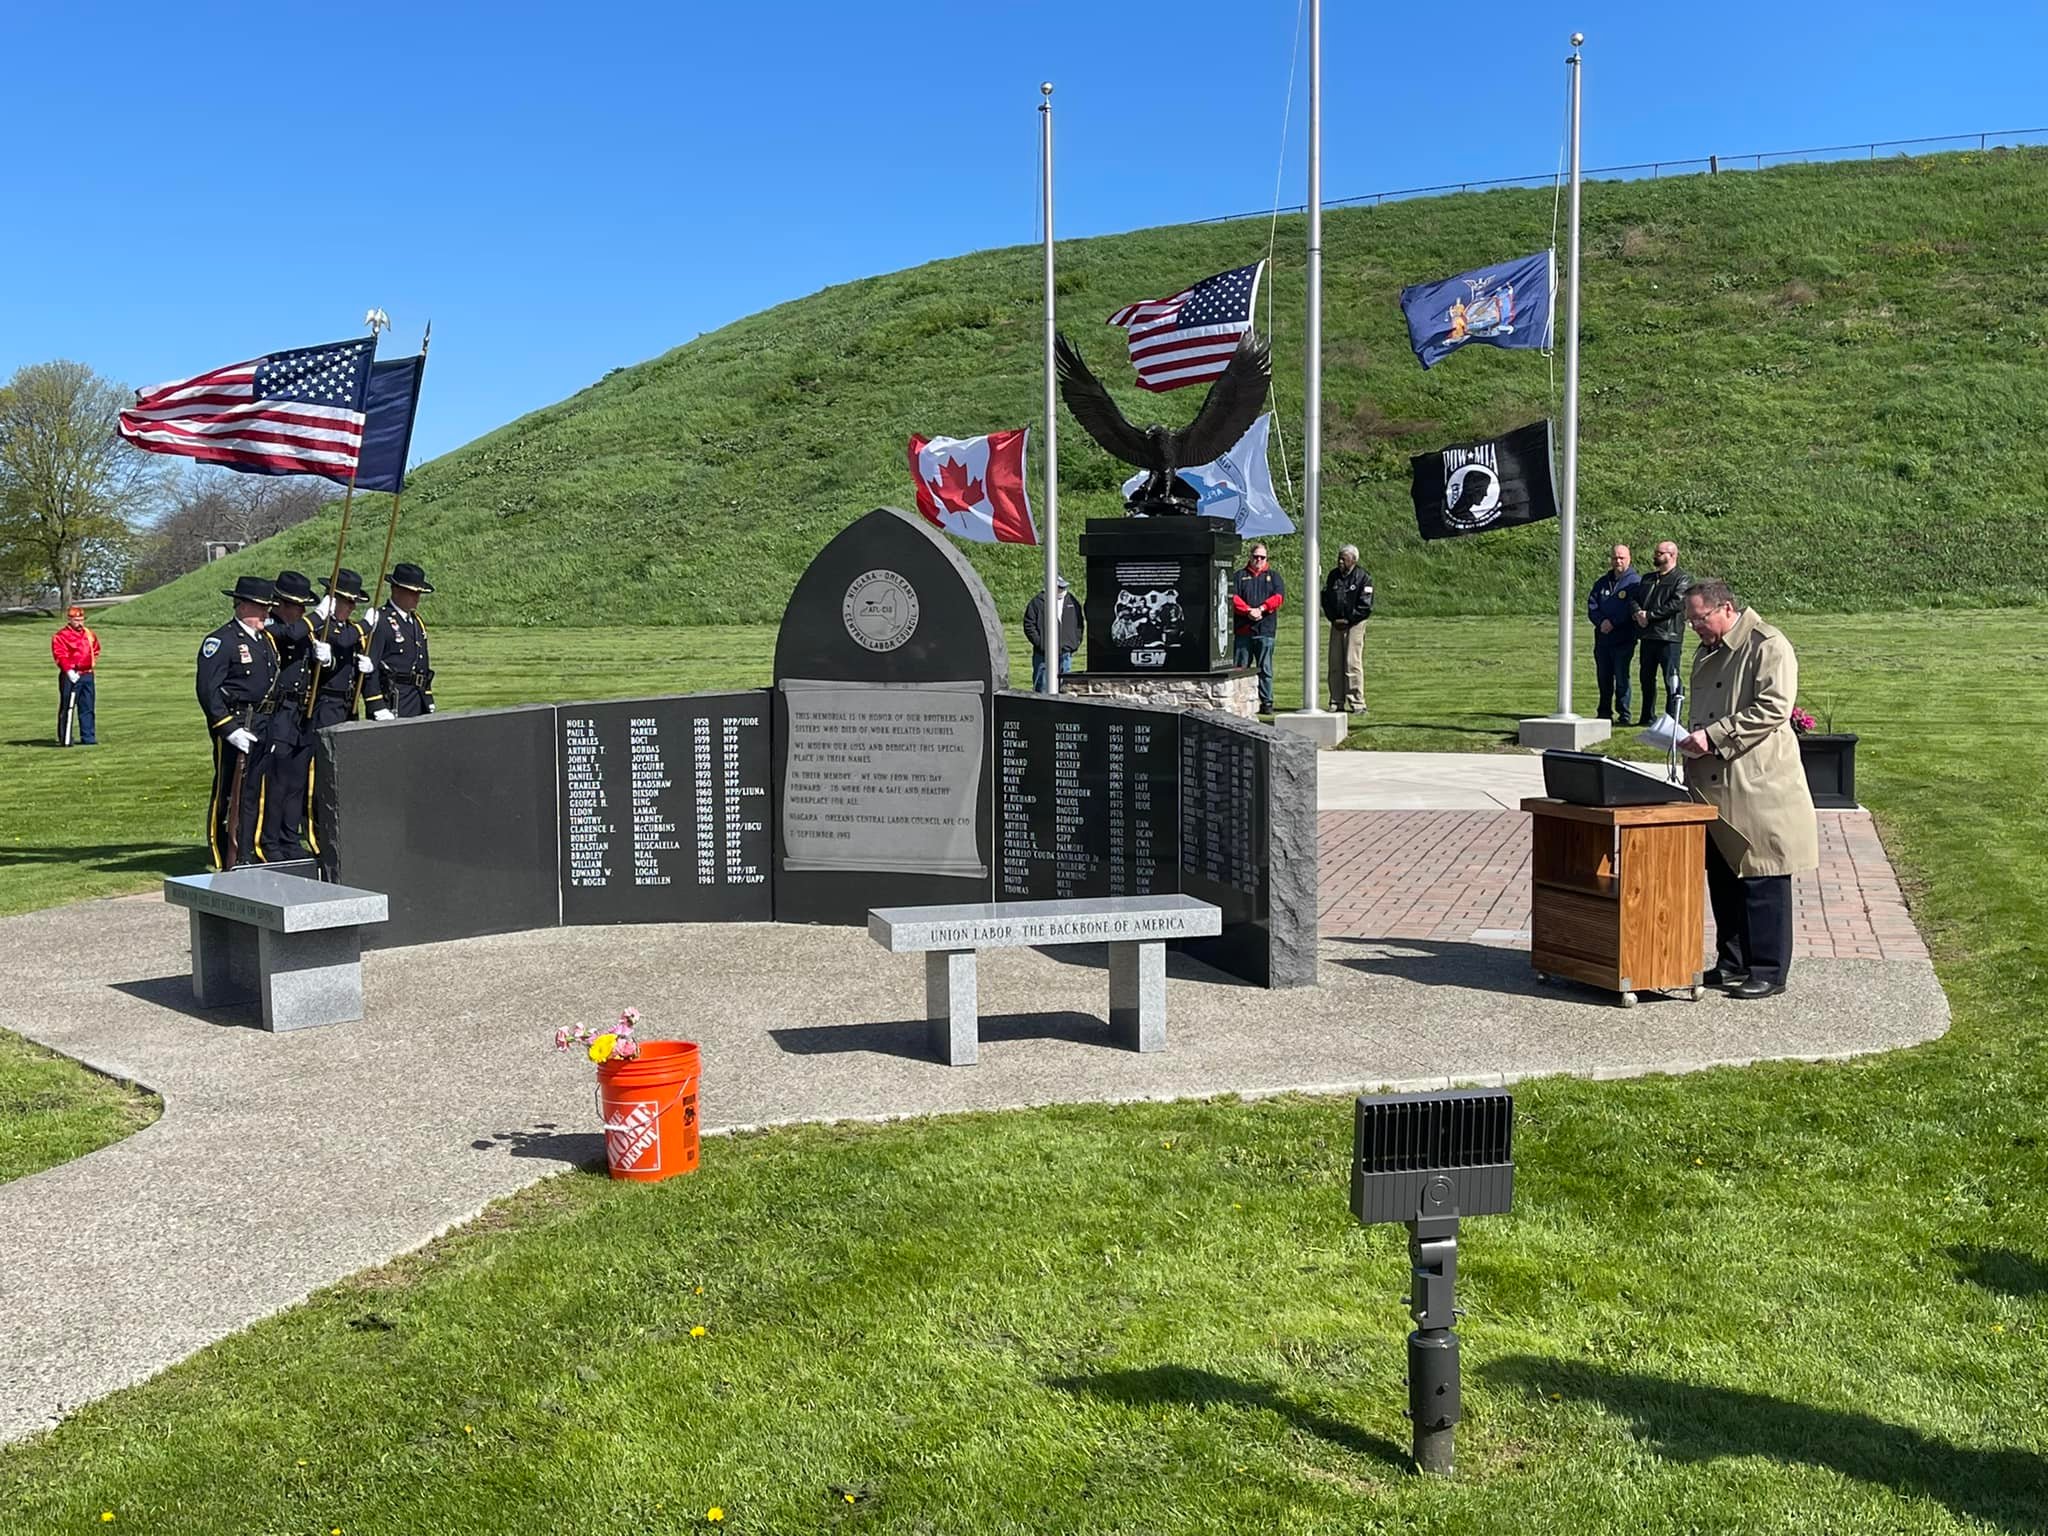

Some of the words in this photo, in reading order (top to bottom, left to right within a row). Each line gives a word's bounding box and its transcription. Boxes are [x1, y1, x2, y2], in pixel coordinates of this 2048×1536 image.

[1442, 449, 1467, 484] POW
[1474, 443, 1498, 476] MIA
[848, 572, 877, 599] NIAGARA
[885, 572, 914, 599] ORLEANS
[845, 613, 867, 645] CENTRAL
[870, 641, 895, 649] LABOR
[896, 614, 917, 643] COUNCIL
[1131, 652, 1166, 665] USW
[568, 782, 601, 790] CHARLES
[569, 799, 598, 808] GEORGE
[570, 825, 607, 833] CLARENCE
[634, 824, 676, 832] McCUBBINS
[726, 840, 741, 848] NPP
[571, 852, 603, 860] BRADLEY
[635, 868, 659, 876] LOGAN
[931, 928, 968, 942] UNION
[1022, 924, 1044, 936] THE
[1050, 921, 1109, 936] BACKBONE
[1114, 920, 1128, 932] OF
[1135, 918, 1184, 930] AMERICA
[621, 1127, 657, 1169] DEPOT
